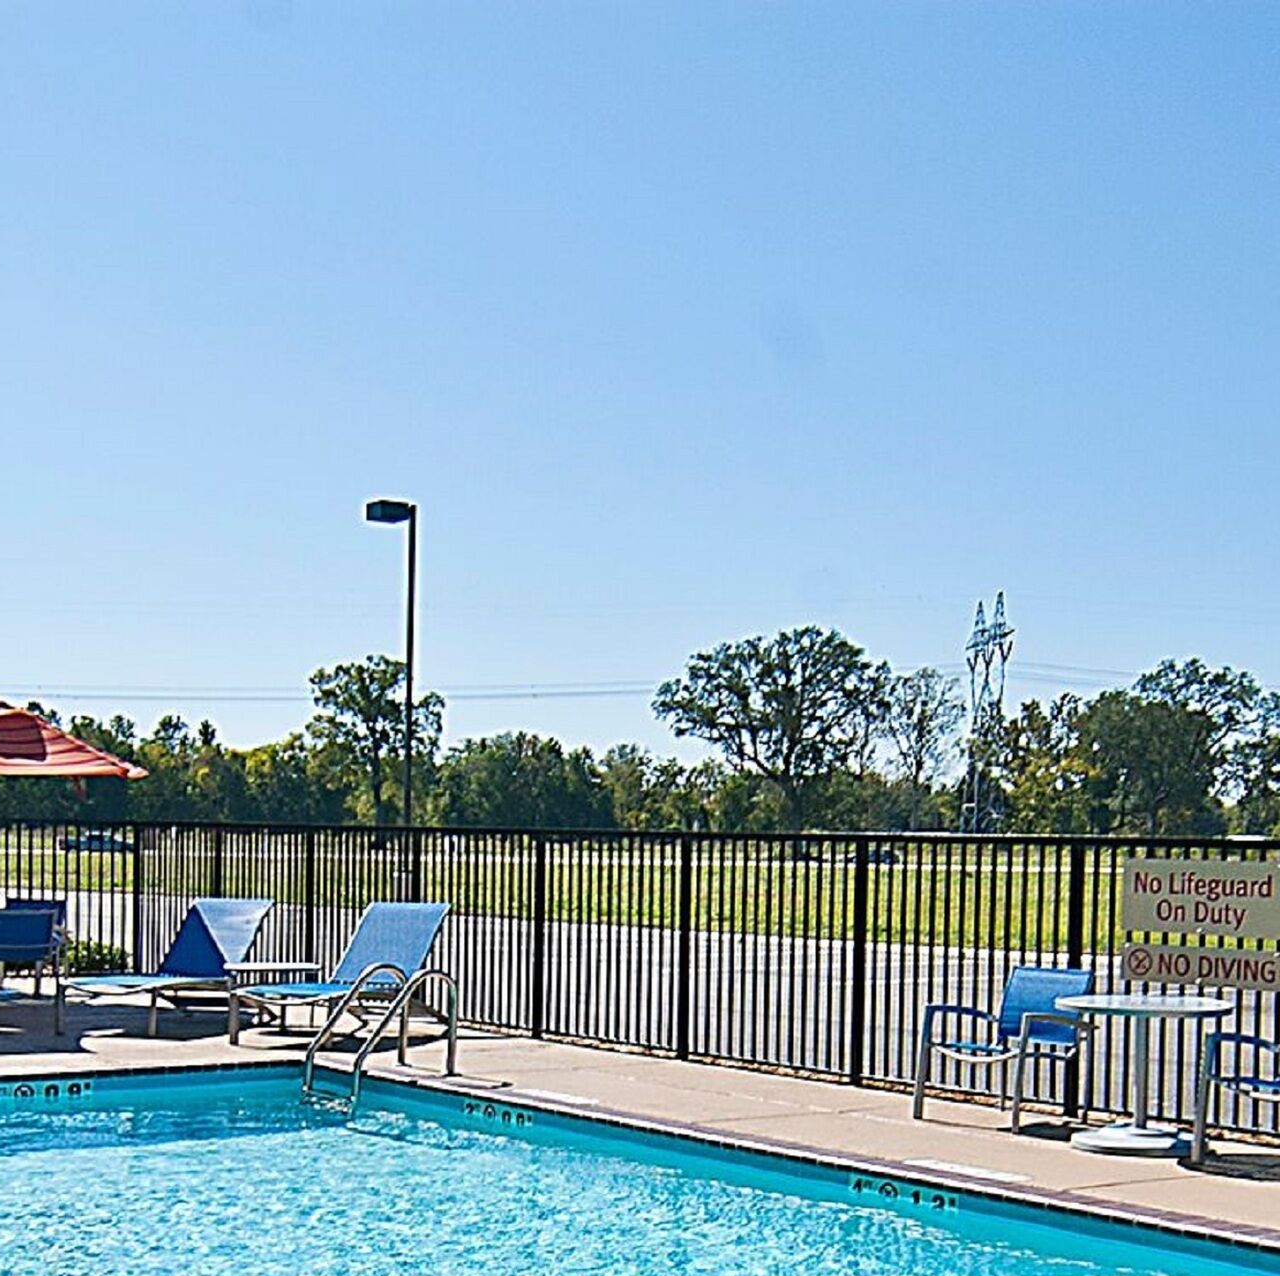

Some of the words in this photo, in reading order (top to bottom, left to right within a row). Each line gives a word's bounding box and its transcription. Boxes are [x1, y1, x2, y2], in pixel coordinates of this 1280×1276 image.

[1133, 871, 1162, 894] No
[1168, 871, 1273, 902] Lifeguard
[1156, 898, 1186, 922] On
[1194, 901, 1247, 931] Duty
[1157, 953, 1191, 977] NO
[1197, 955, 1277, 984] DIVING
